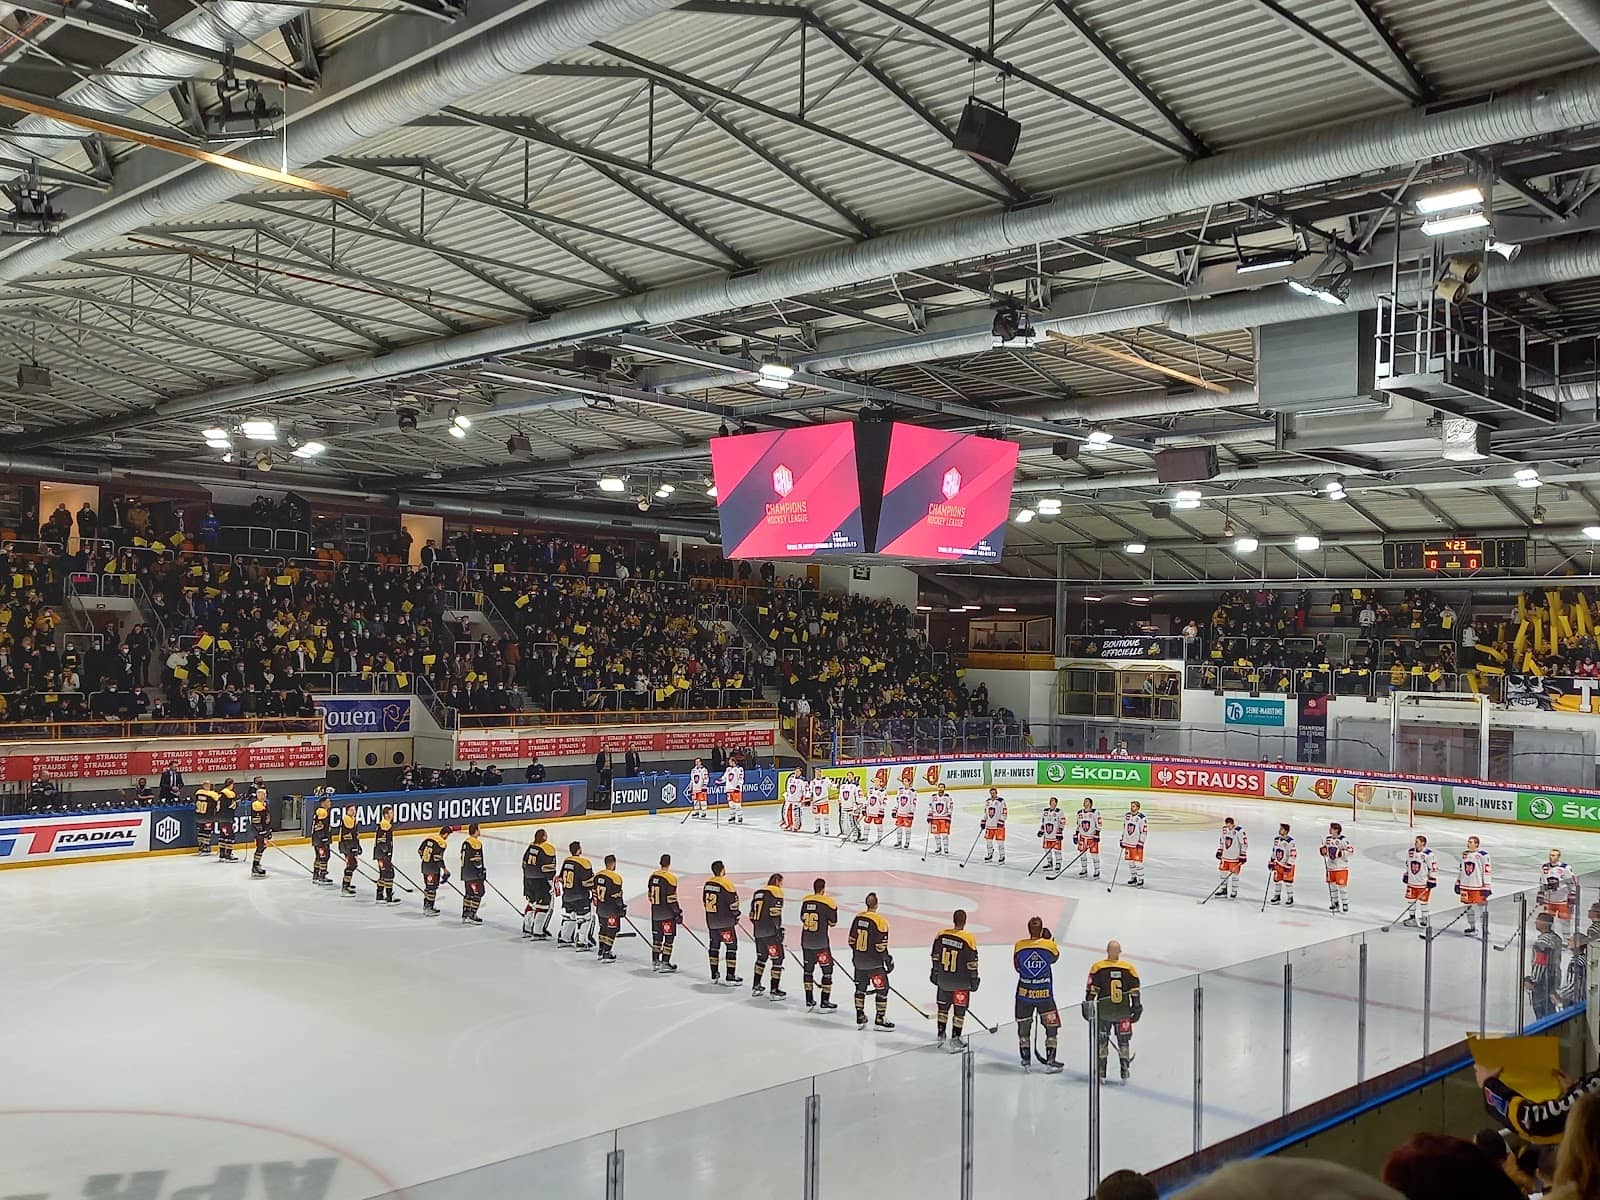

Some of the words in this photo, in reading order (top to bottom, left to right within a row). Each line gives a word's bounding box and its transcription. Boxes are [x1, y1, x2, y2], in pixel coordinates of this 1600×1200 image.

[766, 501, 806, 514] CHAMPIONS
[928, 504, 965, 518] CHAMPIONS
[788, 514, 808, 522] LEAGUE
[1431, 560, 1436, 568] 0
[1470, 559, 1476, 568] 0
[1103, 639, 1140, 649] BOUTIQUE
[1101, 648, 1144, 657] OFFICIELLE
[1230, 704, 1240, 720] 76
[1072, 765, 1141, 780] ŠKODA
[1175, 770, 1259, 791] STRAUSS
[612, 789, 648, 803] EYOND
[330, 802, 432, 828] CAMIONS
[438, 797, 500, 819] HOCKEY
[506, 792, 562, 814] LEAGUE
[1562, 802, 1600, 820] ŠK
[58, 830, 136, 843] RADIAL
[158, 820, 178, 840] CHL
[1111, 980, 1122, 1003] 6
